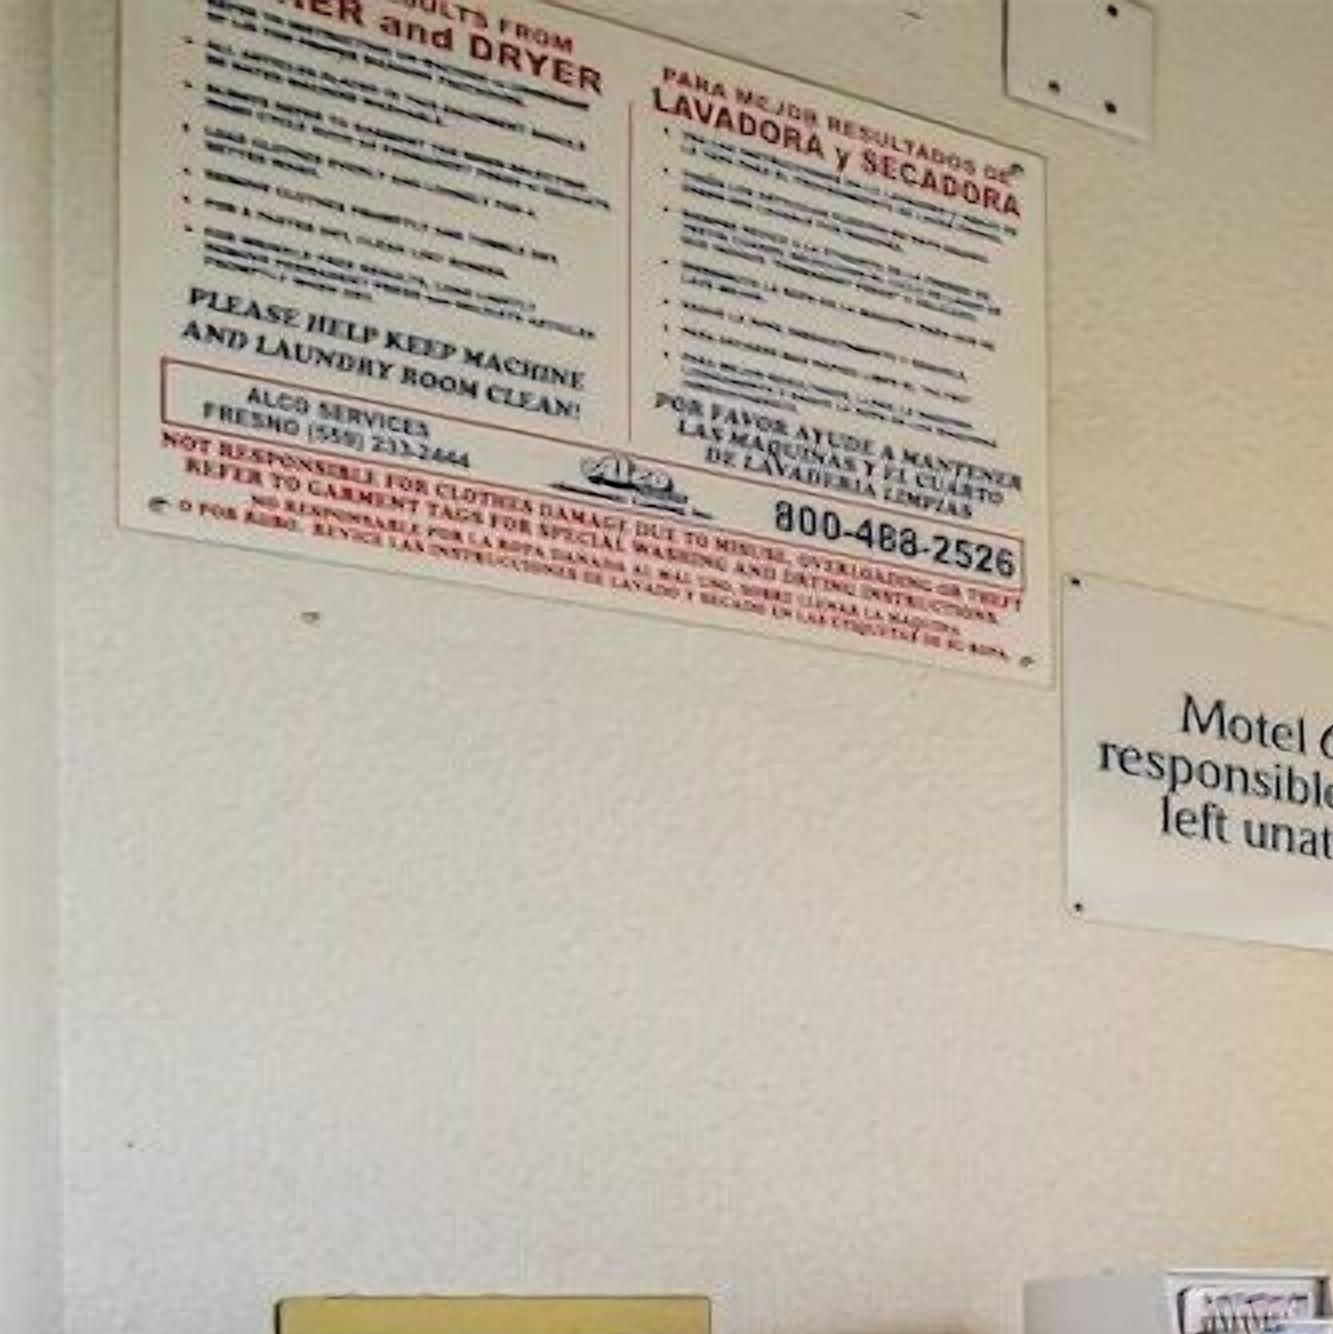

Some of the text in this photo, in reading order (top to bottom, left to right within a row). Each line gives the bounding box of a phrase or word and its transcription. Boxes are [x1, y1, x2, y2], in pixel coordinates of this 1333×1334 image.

[379, 14, 453, 52] and
[469, 33, 604, 95] DRYER
[499, 17, 573, 54] FROM
[652, 86, 825, 160] LAVADORA
[862, 148, 1021, 218] SECADORA
[663, 66, 728, 99] PARA
[827, 115, 977, 177] RESULTADOS
[182, 319, 248, 349] AND
[256, 335, 395, 380] LAUNDRY
[400, 366, 478, 399] ROOM
[188, 287, 584, 390] PLEASE HELP KEEP MACHINE
[162, 430, 211, 454] NOT
[219, 440, 374, 484] RESPONSIBLE
[319, 401, 429, 438] SERVICES
[775, 500, 1016, 578] 800-488-2526
[1181, 693, 1307, 756] Motel
[1160, 795, 1231, 845] left
